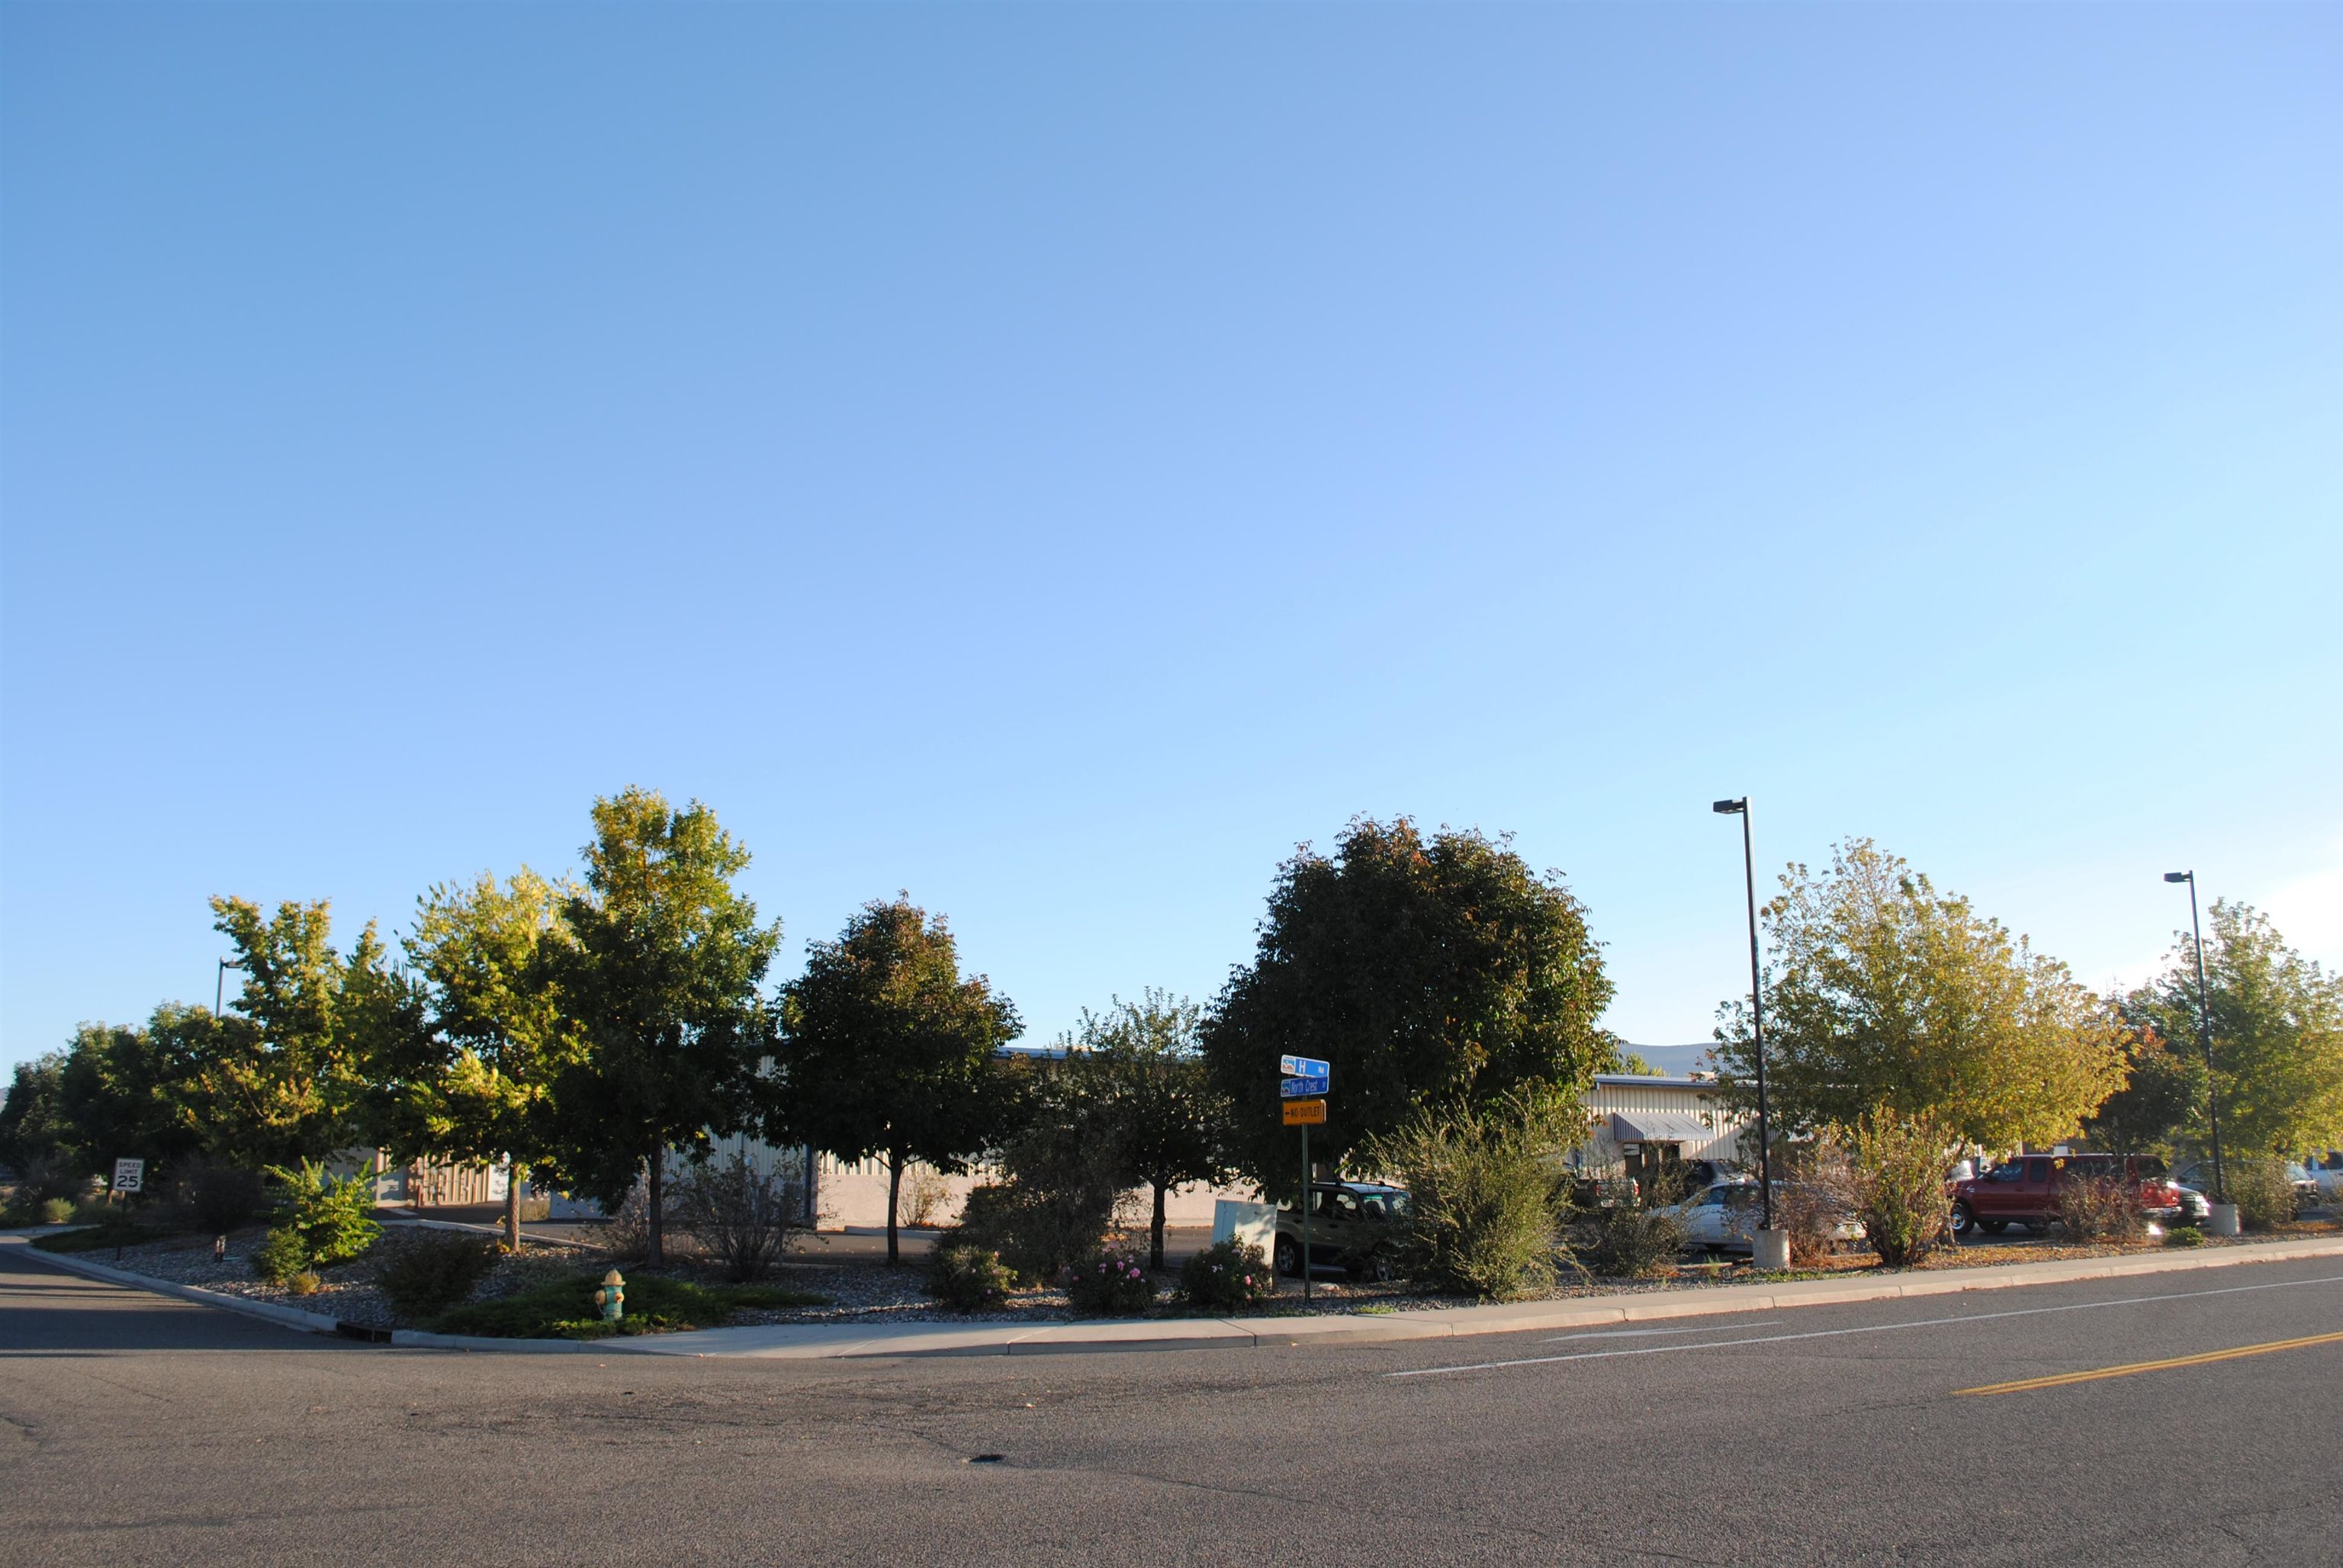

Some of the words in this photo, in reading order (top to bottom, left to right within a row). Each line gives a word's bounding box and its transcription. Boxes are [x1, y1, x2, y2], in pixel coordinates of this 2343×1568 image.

[1299, 1060, 1306, 1073] H
[1291, 1082, 1303, 1093] North
[1306, 1080, 1318, 1091] Crest
[1290, 1107, 1298, 1117] NO
[1300, 1106, 1320, 1117] OUTLET
[117, 1174, 138, 1187] 25
